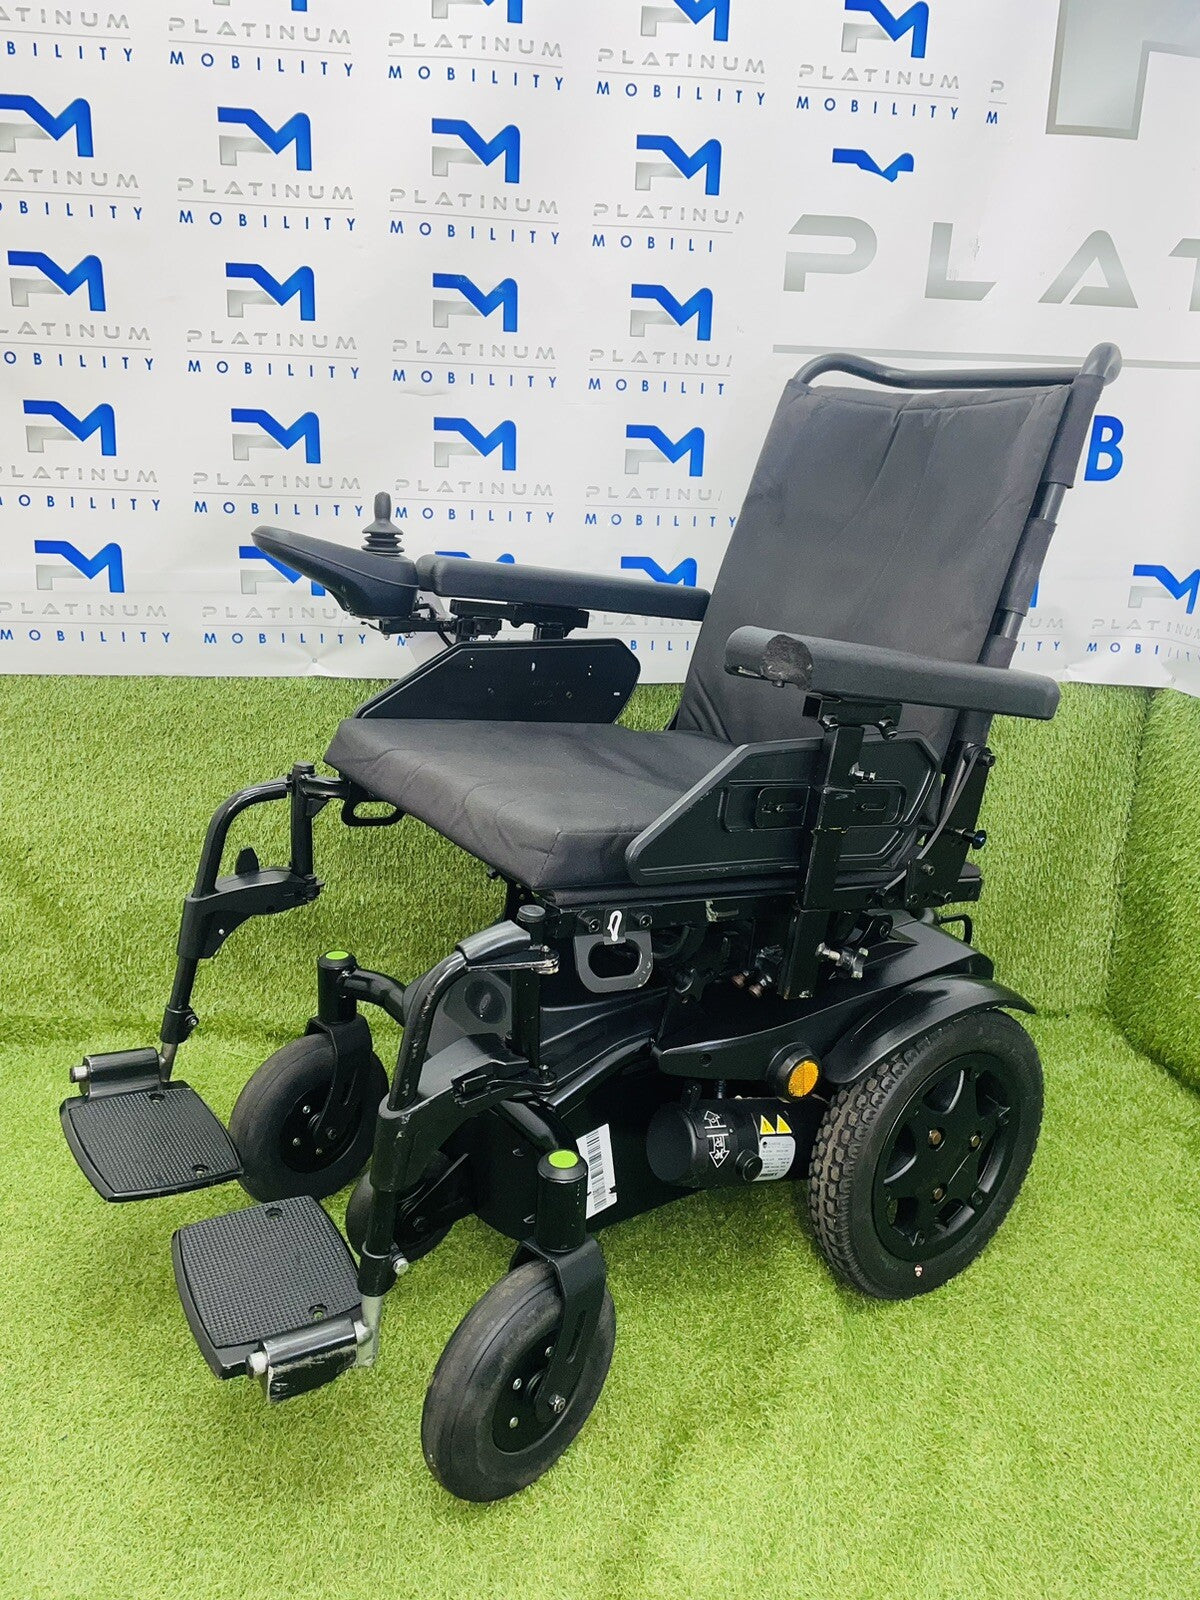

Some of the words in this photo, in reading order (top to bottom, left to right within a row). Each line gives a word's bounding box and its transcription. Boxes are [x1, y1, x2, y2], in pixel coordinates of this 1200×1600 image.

[168, 17, 350, 44] PLATINUM
[388, 33, 562, 57] PLATINUM
[169, 51, 353, 77] MOBILITY
[597, 48, 765, 74] PLATINUM
[388, 65, 564, 91] MOBILITY
[798, 64, 960, 90] PLATINUM
[596, 81, 765, 105] MOBILITY
[796, 96, 959, 120] MOBILITY
[177, 177, 353, 201] PLATINUM
[0, 200, 142, 221] BILITY
[389, 188, 558, 214] PLATINUM
[179, 210, 355, 231] MOBILITY
[390, 221, 559, 245] MOBILITY
[592, 234, 713, 252] MOBILI
[186, 329, 357, 350] PLATINUM
[392, 339, 555, 360] PLATINUM
[4, 351, 153, 370] OBILITY
[188, 360, 359, 379] MOBILITY
[393, 370, 557, 388] MOBILITY
[588, 378, 724, 395] MOBILIT
[193, 472, 361, 489] PLATINUM
[395, 479, 552, 497] PLATINUM
[194, 501, 363, 517] MOBILITY
[395, 506, 554, 523] MOBILITY
[585, 514, 736, 527] MOBILITY
[0, 602, 166, 617] PLATINUM
[1, 630, 170, 643] MOBILITY
[204, 633, 366, 644] MOBILITY
